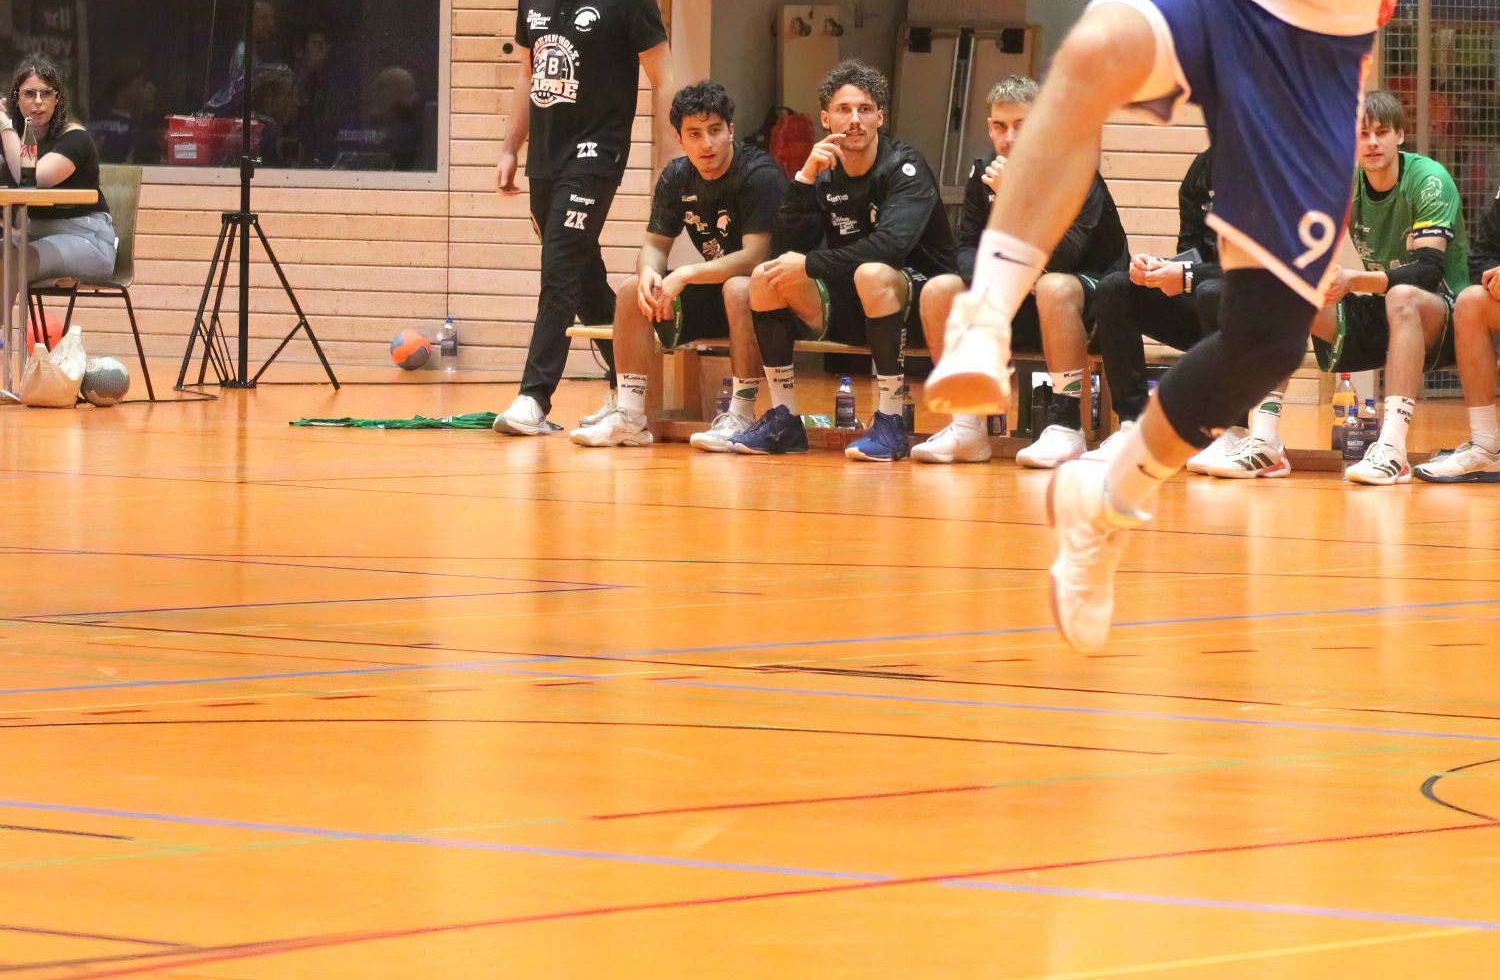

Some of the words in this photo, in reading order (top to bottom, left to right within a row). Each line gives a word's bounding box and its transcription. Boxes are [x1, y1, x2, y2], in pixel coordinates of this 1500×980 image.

[577, 142, 598, 158] ZK
[564, 210, 588, 230] ZK
[1295, 210, 1336, 269] 9
